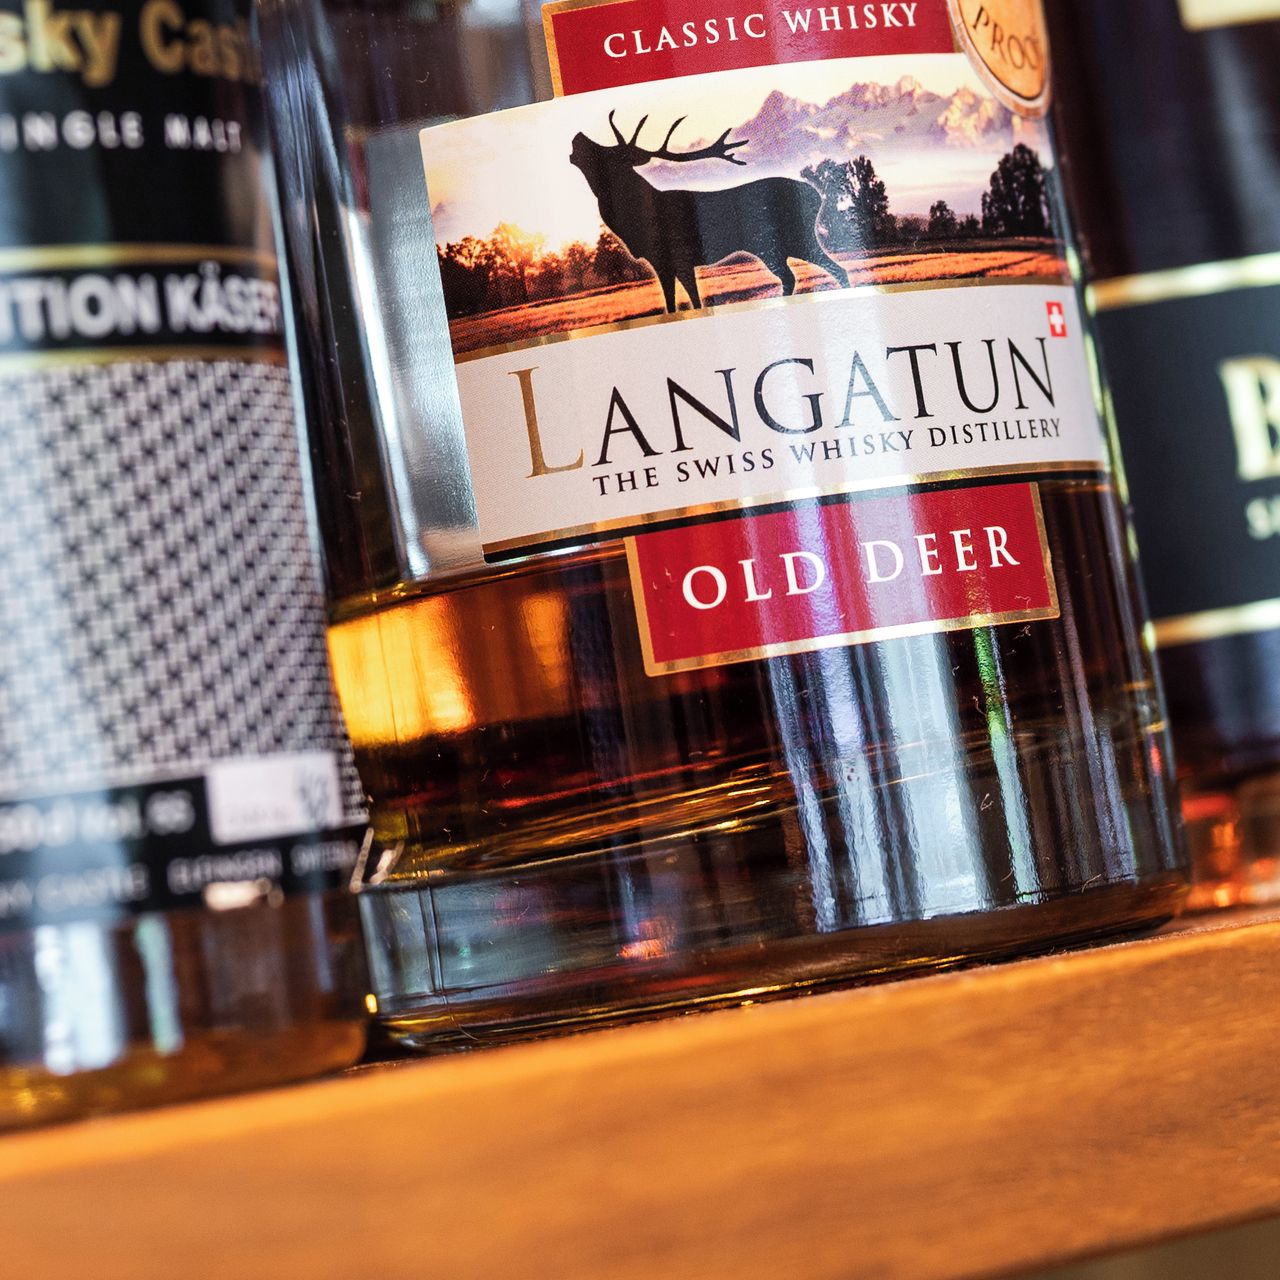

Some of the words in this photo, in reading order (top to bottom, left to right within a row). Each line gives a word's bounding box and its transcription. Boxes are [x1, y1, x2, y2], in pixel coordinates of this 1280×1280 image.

[603, 13, 766, 58] CLASSIC
[781, 2, 918, 33] WHISKY
[508, 336, 1056, 479] LANGATUN
[593, 468, 660, 496] THE
[677, 448, 774, 484] SWISS
[789, 428, 914, 465] WHISKY
[928, 417, 1061, 449] DISTILLERY
[682, 550, 826, 610] OLD
[865, 525, 1020, 585] DEER
